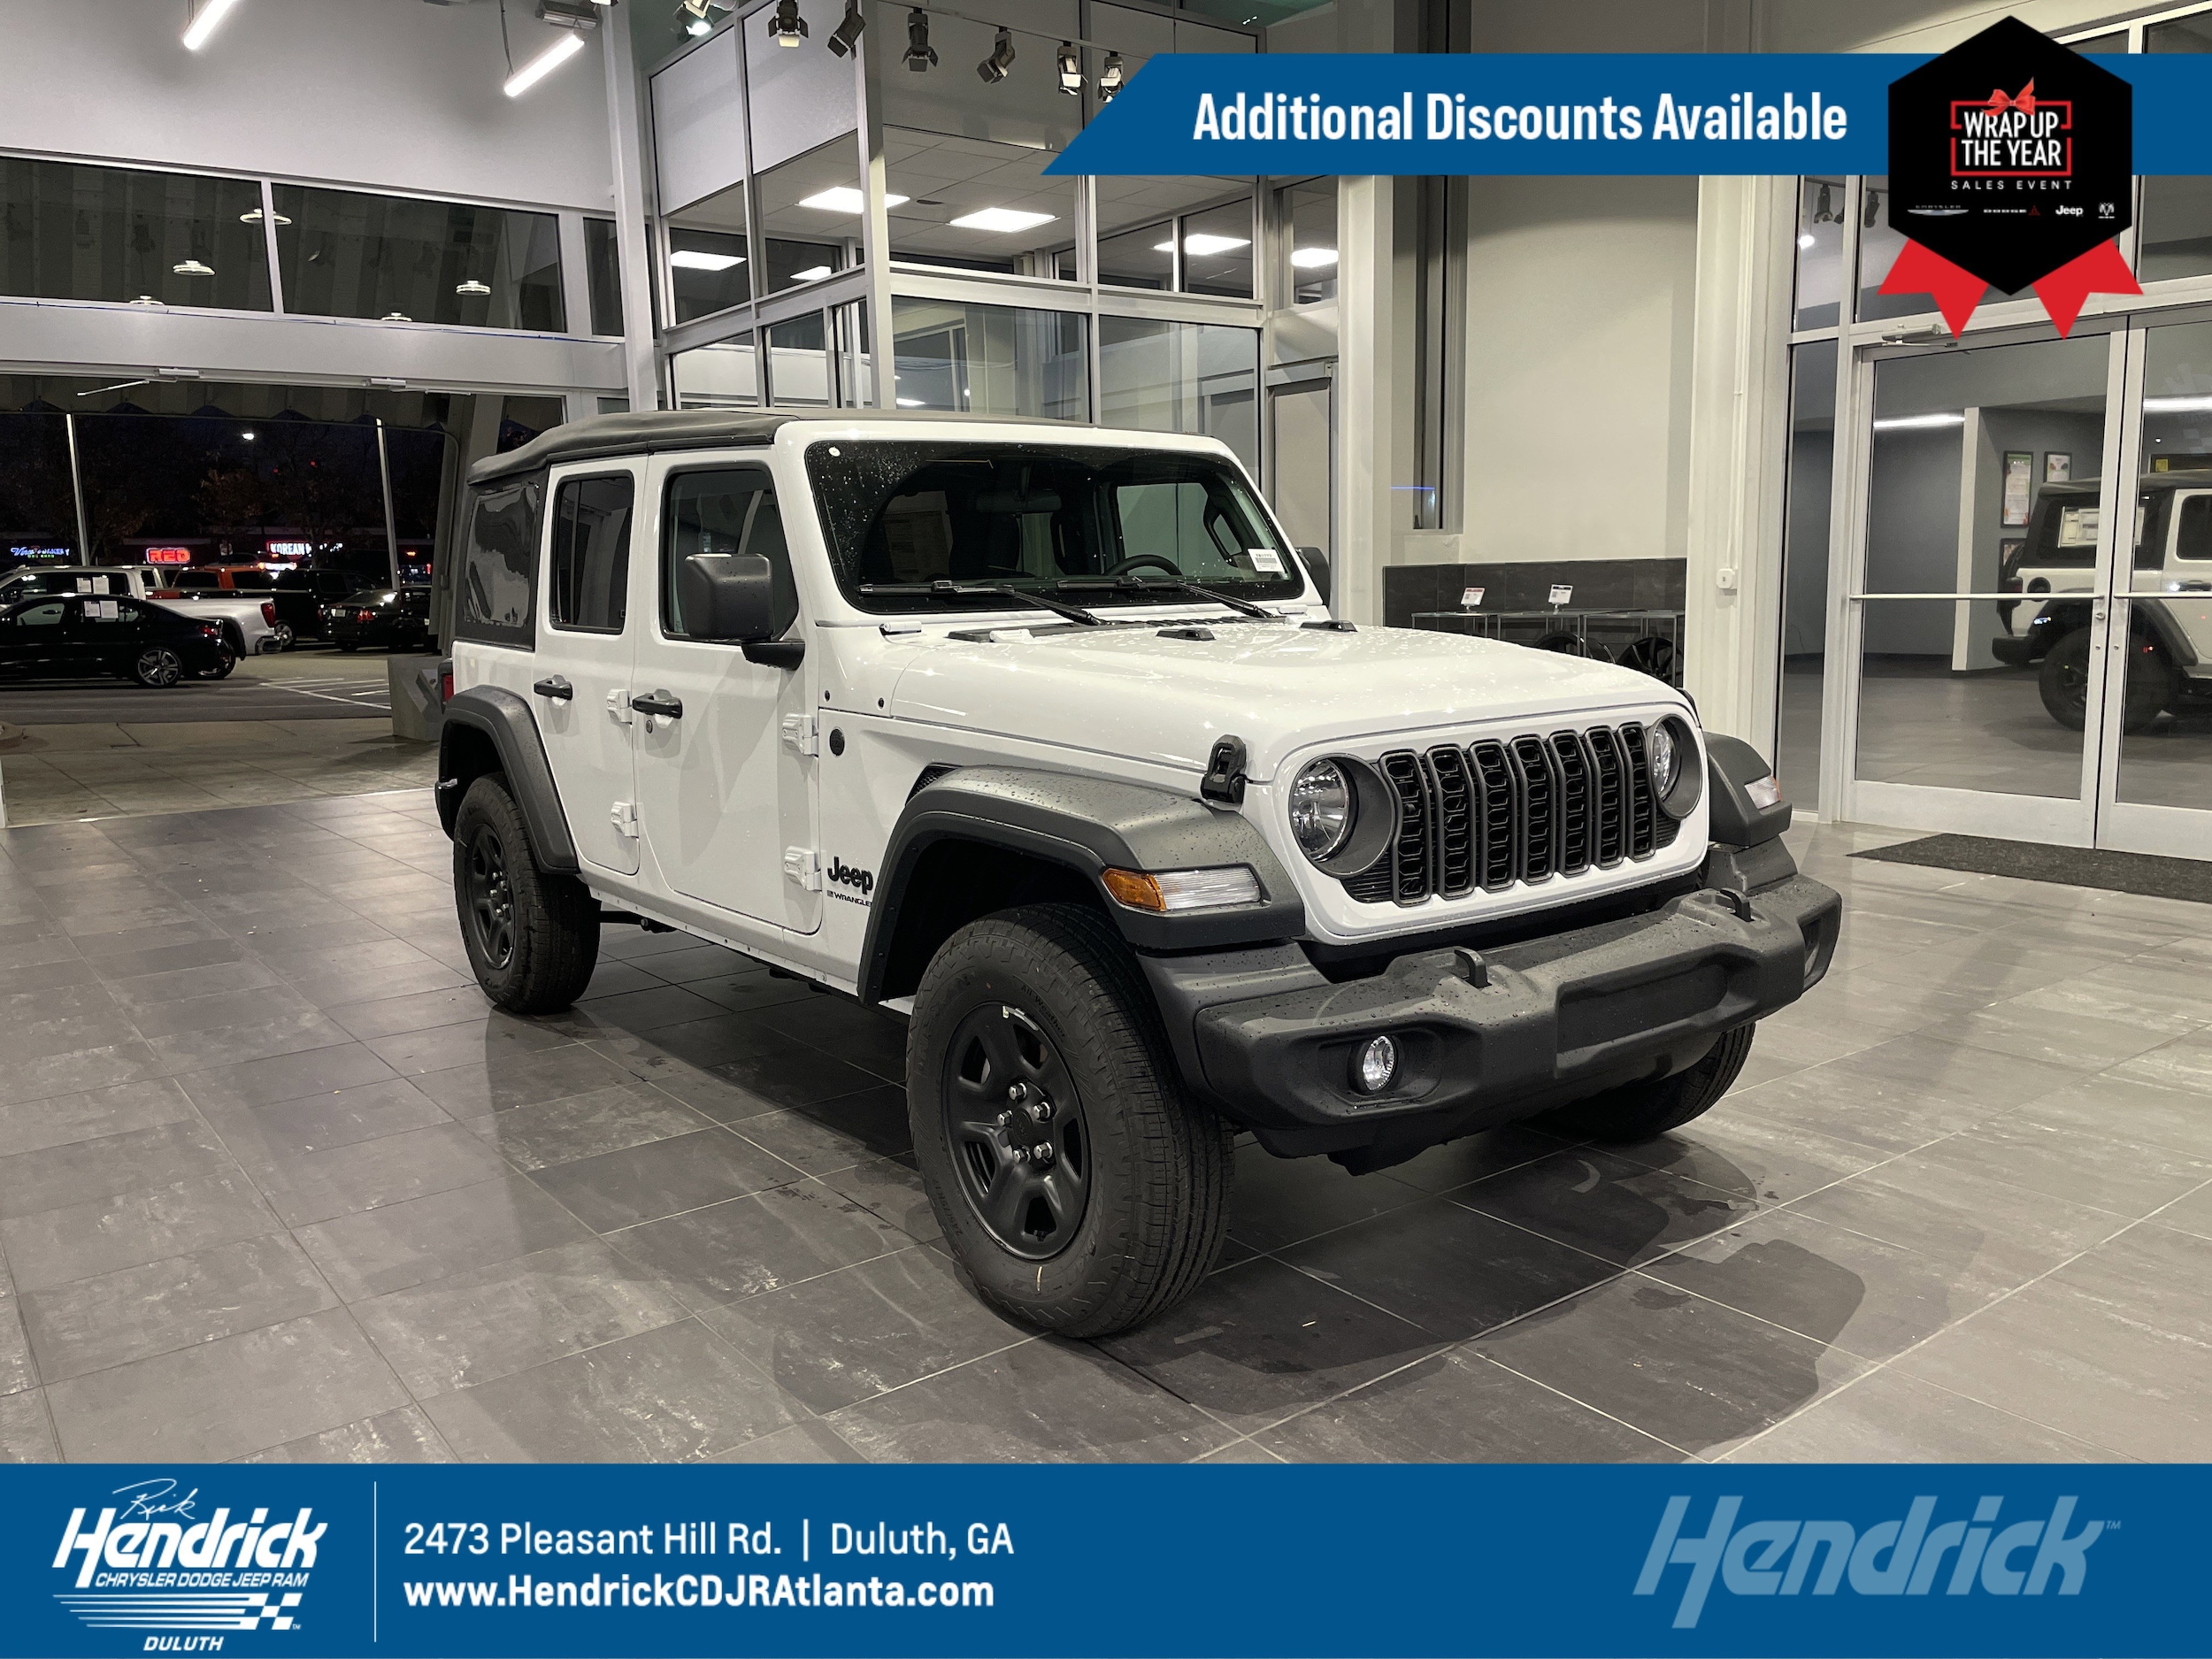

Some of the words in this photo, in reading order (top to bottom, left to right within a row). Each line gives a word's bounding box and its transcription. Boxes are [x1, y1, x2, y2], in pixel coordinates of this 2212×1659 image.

[148, 549, 190, 562] RED
[270, 542, 305, 556] KOREAN
[826, 855, 874, 895] Jeep
[833, 891, 873, 908] WRANGLE
